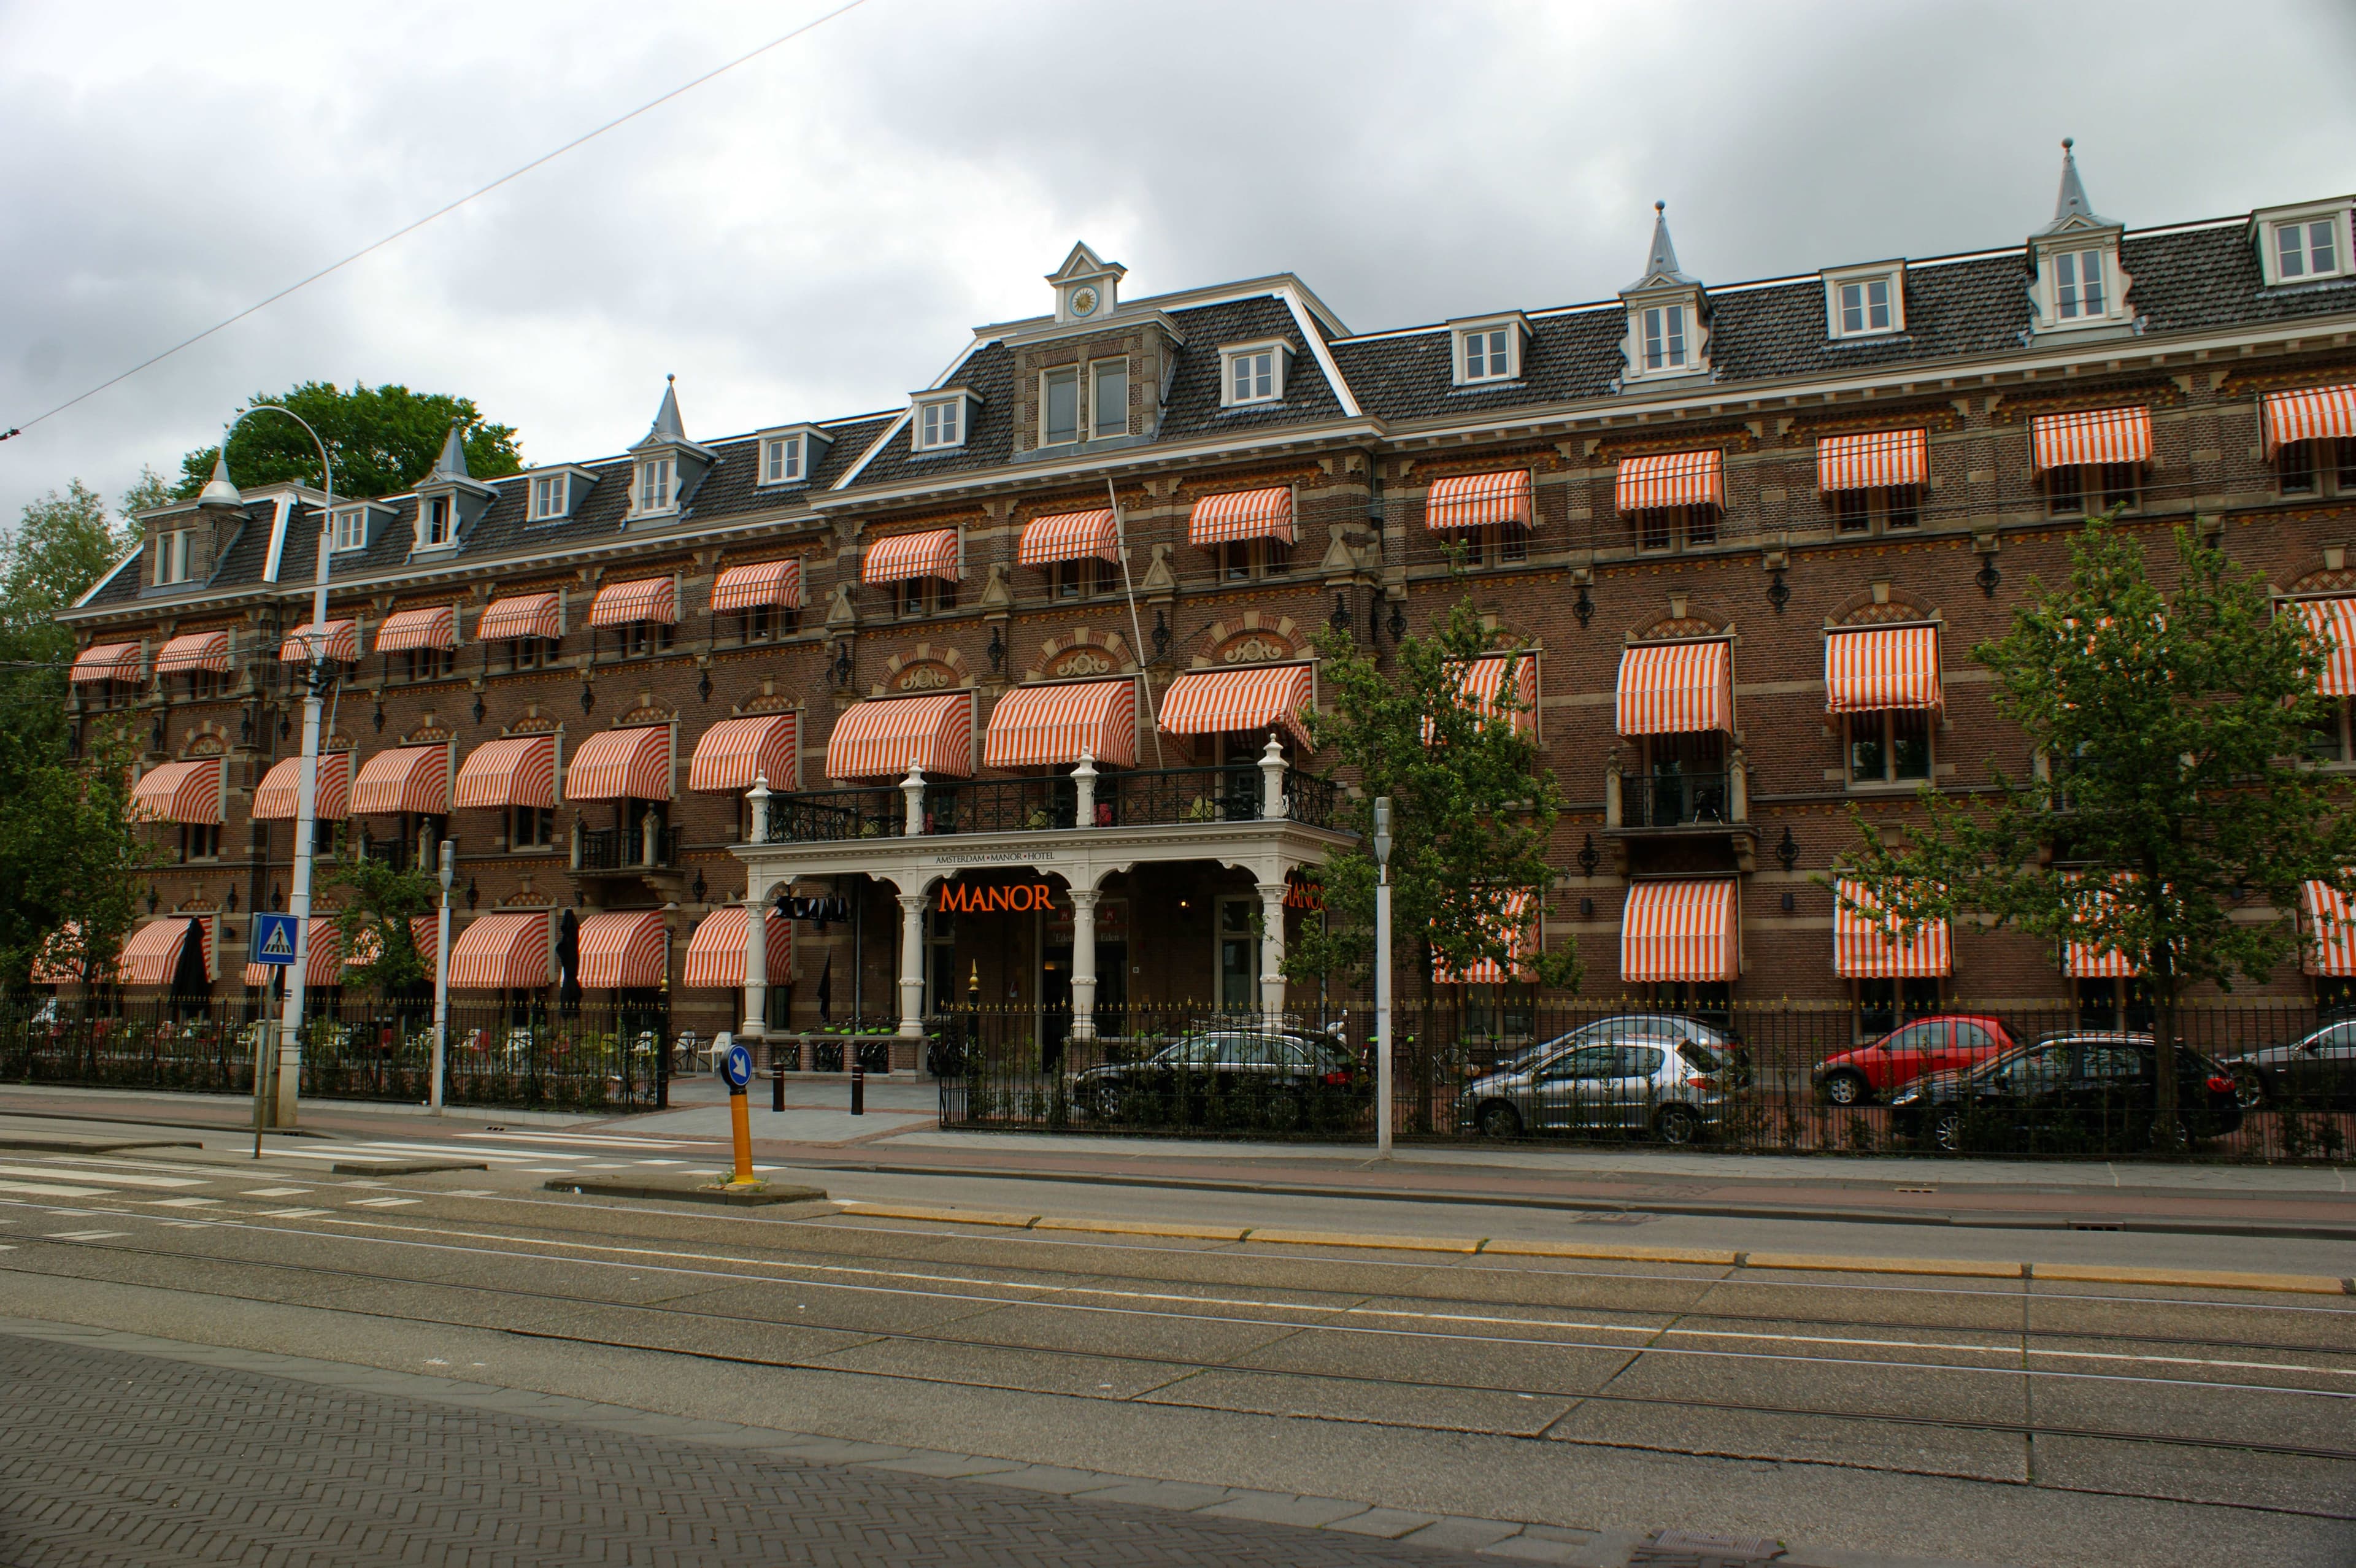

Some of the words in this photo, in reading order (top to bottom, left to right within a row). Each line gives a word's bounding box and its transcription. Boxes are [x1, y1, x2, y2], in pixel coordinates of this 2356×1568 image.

[936, 855, 985, 864] AMSTERDAM
[991, 853, 1022, 861] MANOR
[1028, 851, 1055, 860] HOTEL
[939, 883, 1056, 912] MANOR
[1101, 933, 1119, 942] Eden
